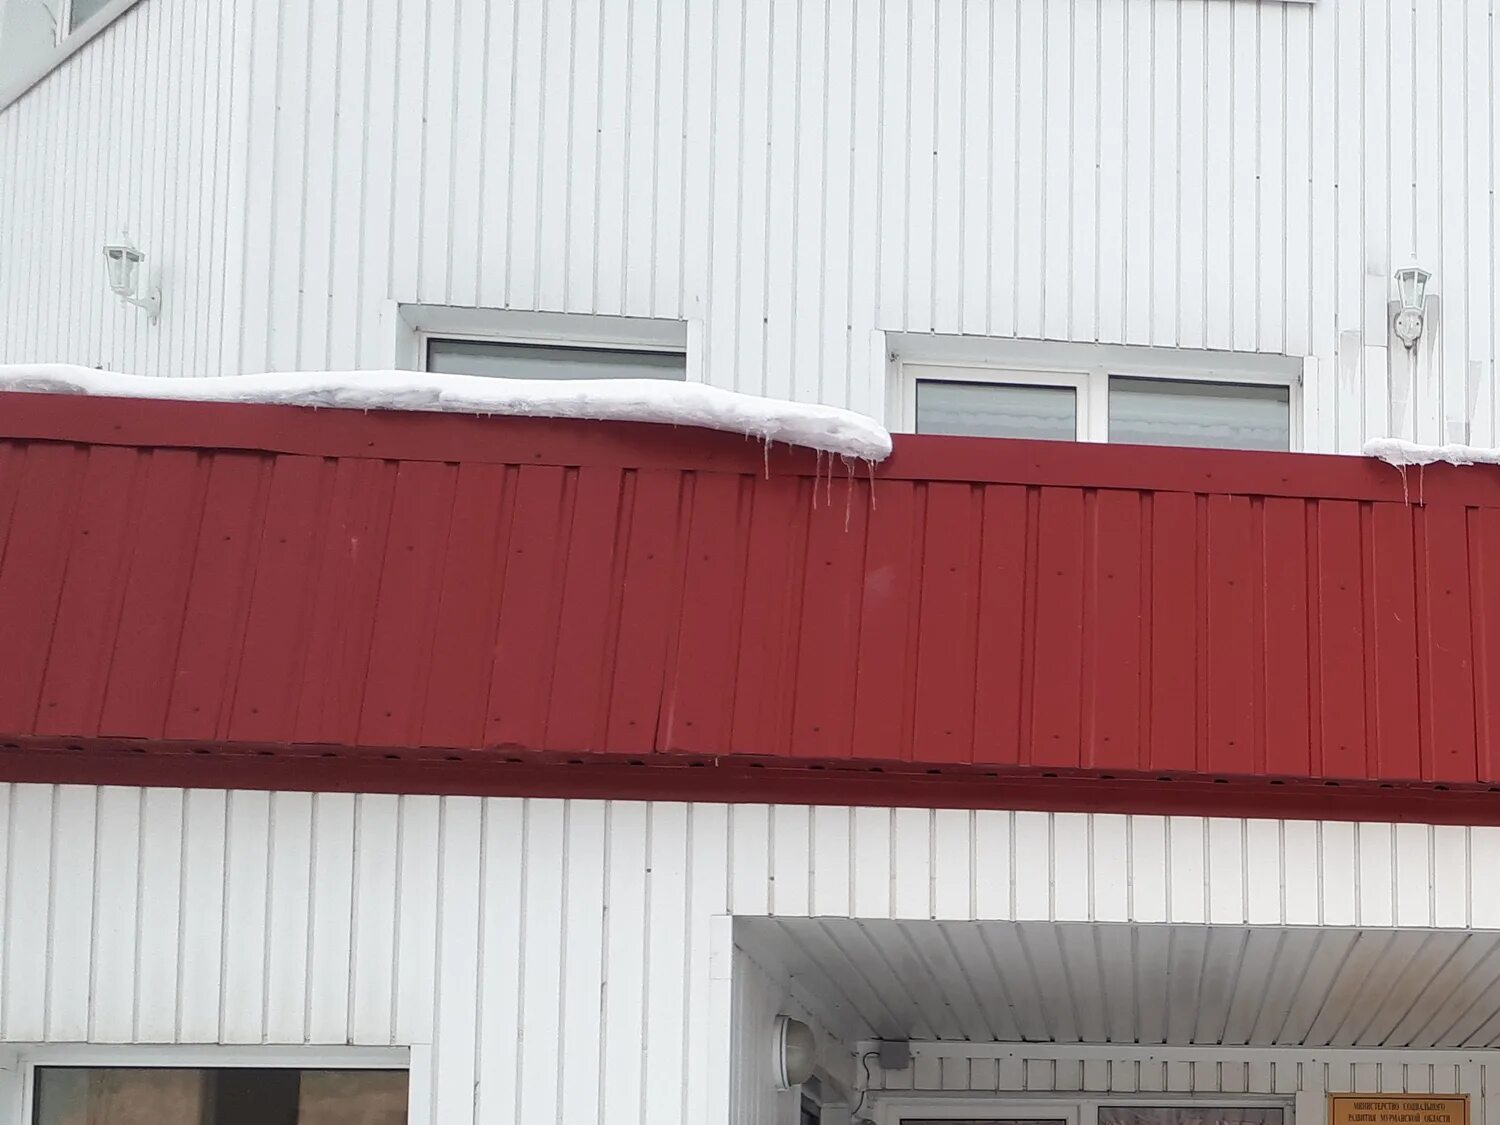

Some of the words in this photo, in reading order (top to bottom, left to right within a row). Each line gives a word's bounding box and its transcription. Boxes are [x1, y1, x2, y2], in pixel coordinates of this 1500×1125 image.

[1353, 1102, 1400, 1111] МИНИСТЕРСТВО
[1403, 1102, 1446, 1111] СОЦИАЛЬНОГО
[1380, 1113, 1421, 1123] МУРМАНСКОЙ
[1424, 1114, 1451, 1123] ОБЛАСТИ
